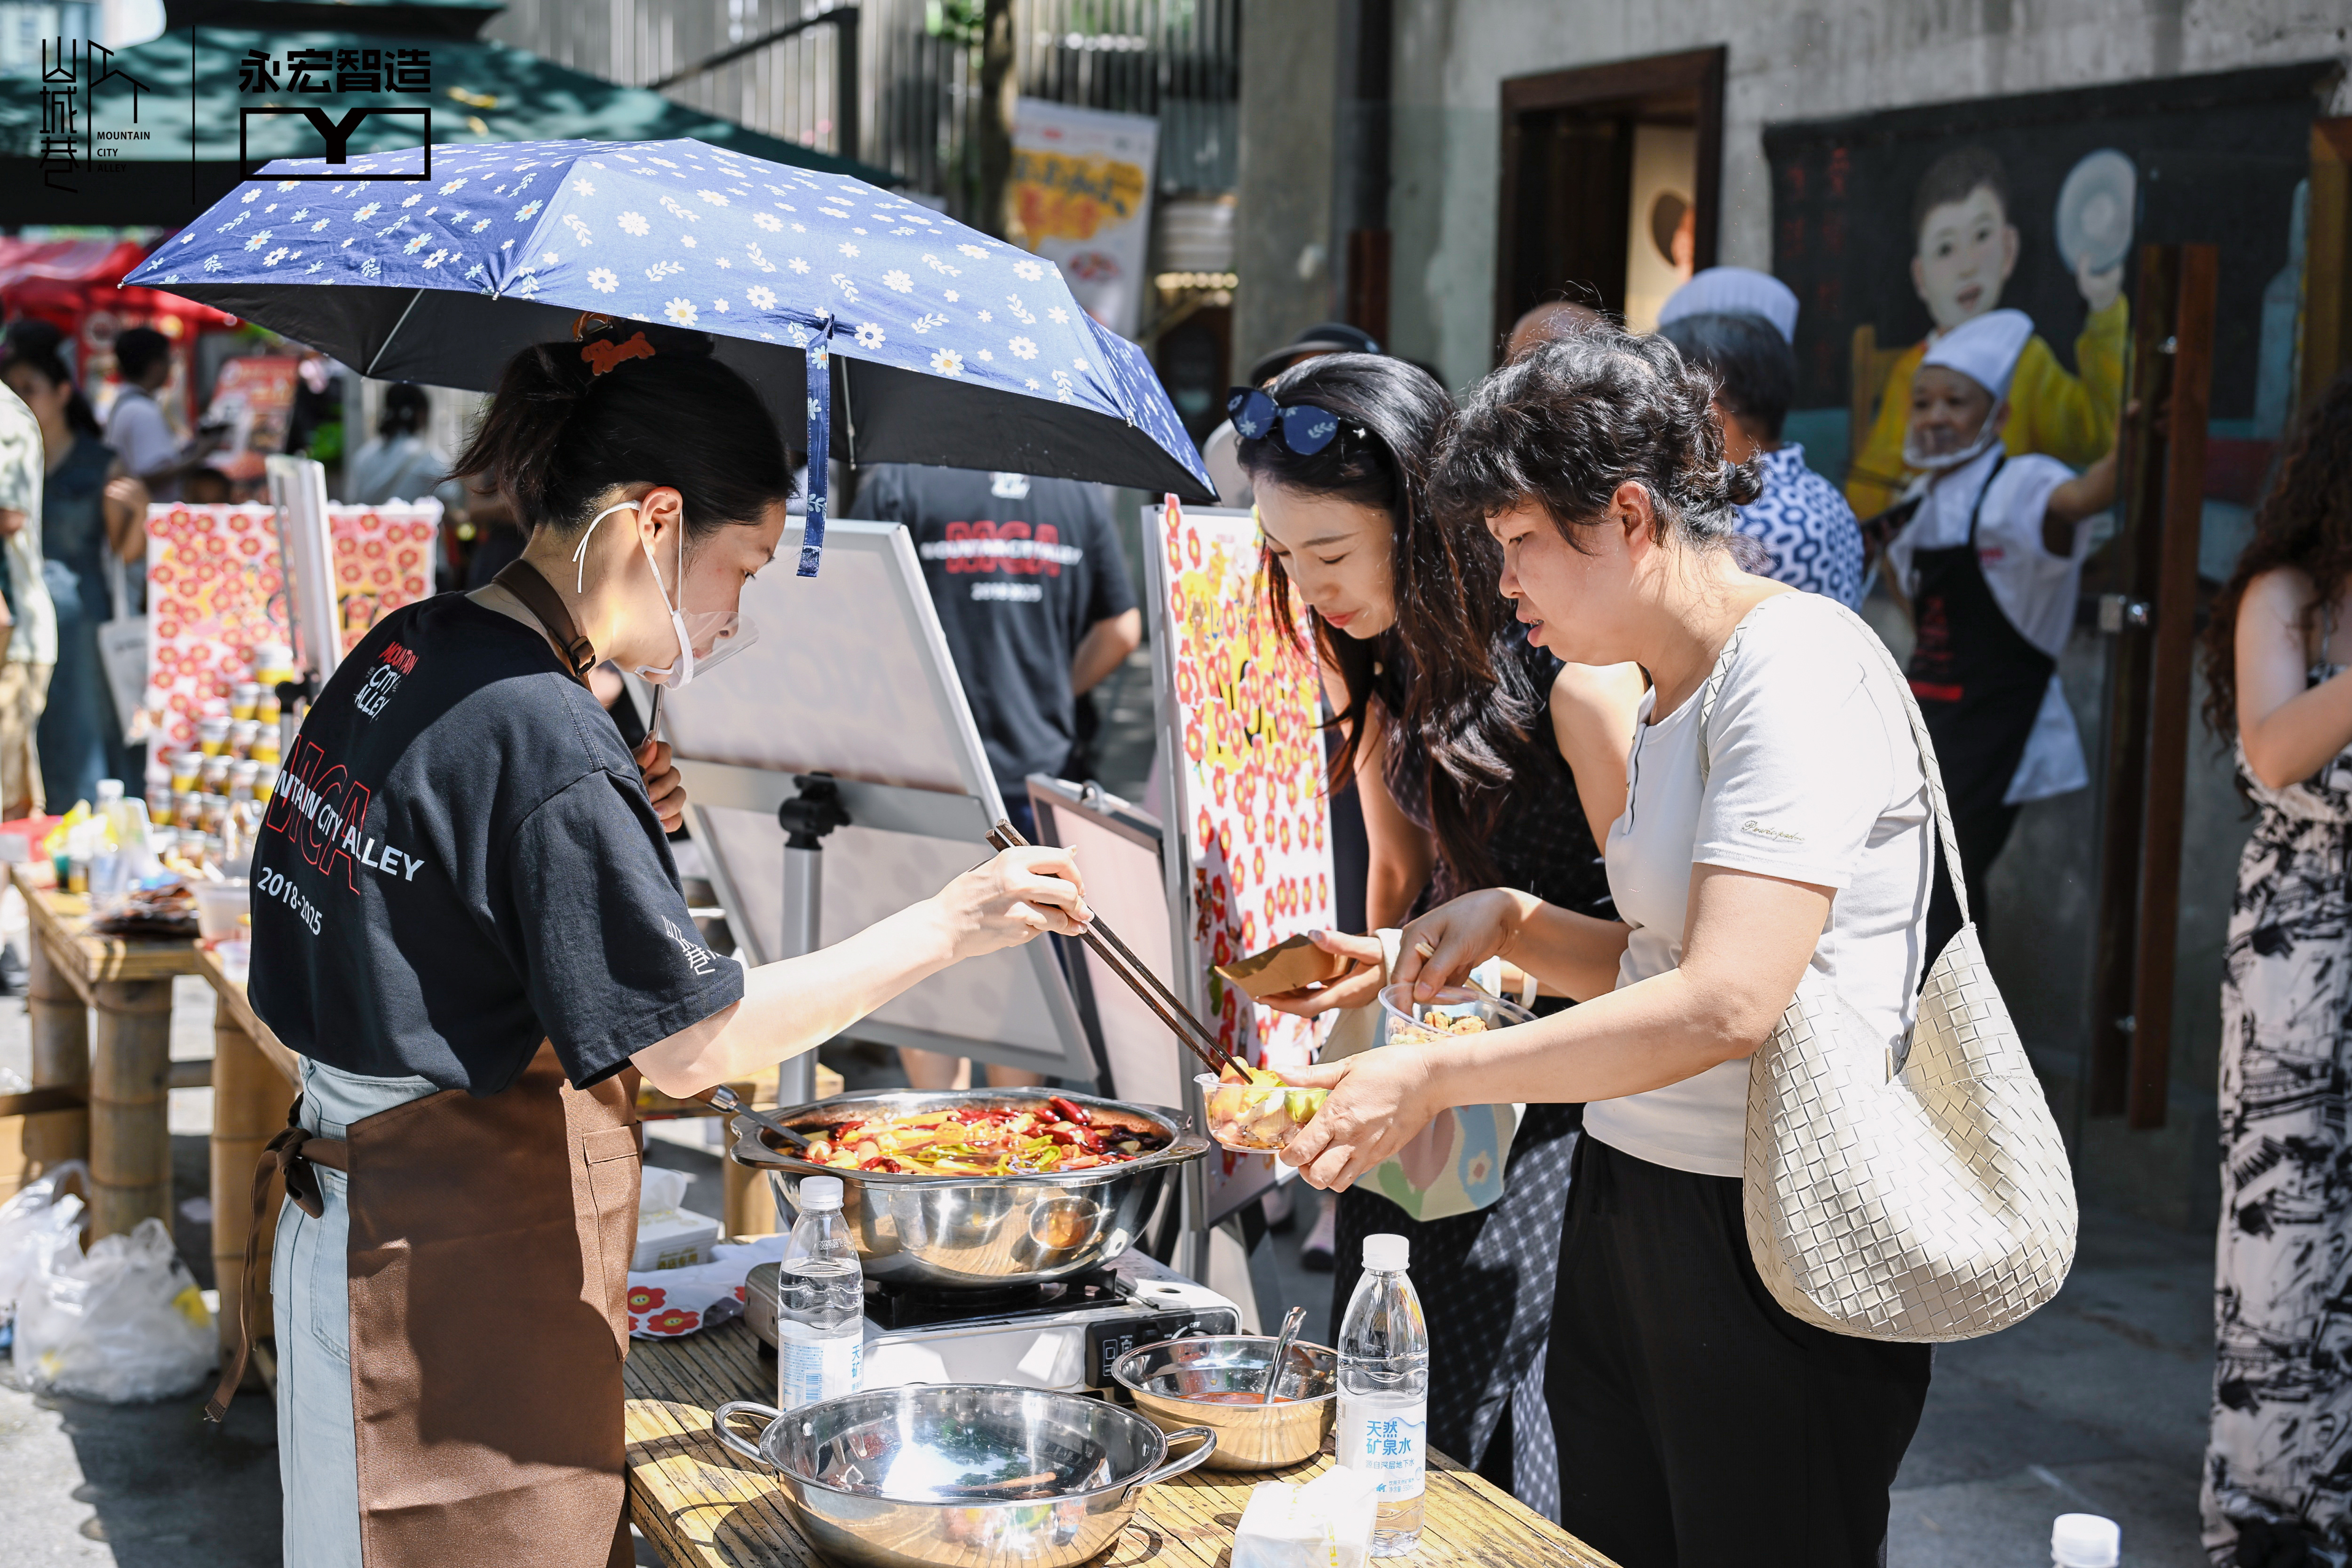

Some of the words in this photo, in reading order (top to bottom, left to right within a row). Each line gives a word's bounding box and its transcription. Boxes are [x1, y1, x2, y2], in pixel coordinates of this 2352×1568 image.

[378, 641, 419, 676] MOUNTAIN
[370, 664, 401, 696] CITY
[353, 684, 391, 724] ALLEY
[318, 804, 343, 842] CITY
[342, 825, 425, 882] ALLEY
[258, 867, 323, 936] 2018-2025
[1367, 1420, 1398, 1438] 天然
[1366, 1437, 1412, 1456] 矿泉水
[1366, 1458, 1414, 1469] 源自深层地下水
